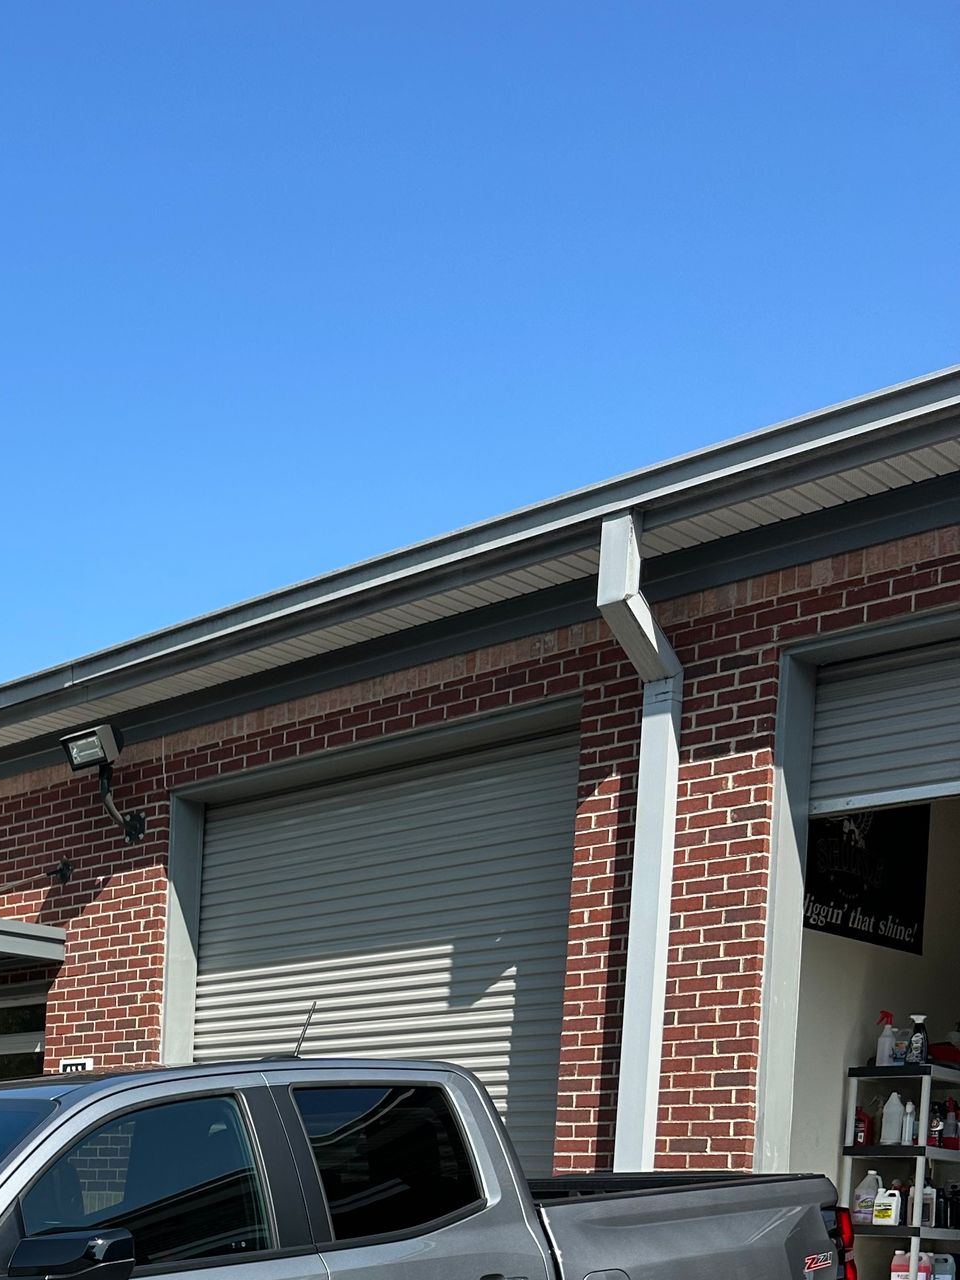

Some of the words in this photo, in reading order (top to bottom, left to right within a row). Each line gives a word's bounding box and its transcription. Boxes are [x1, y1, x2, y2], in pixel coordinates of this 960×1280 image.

[848, 907, 875, 933] that
[878, 915, 918, 943] shine!
[804, 1251, 833, 1273] Z71
